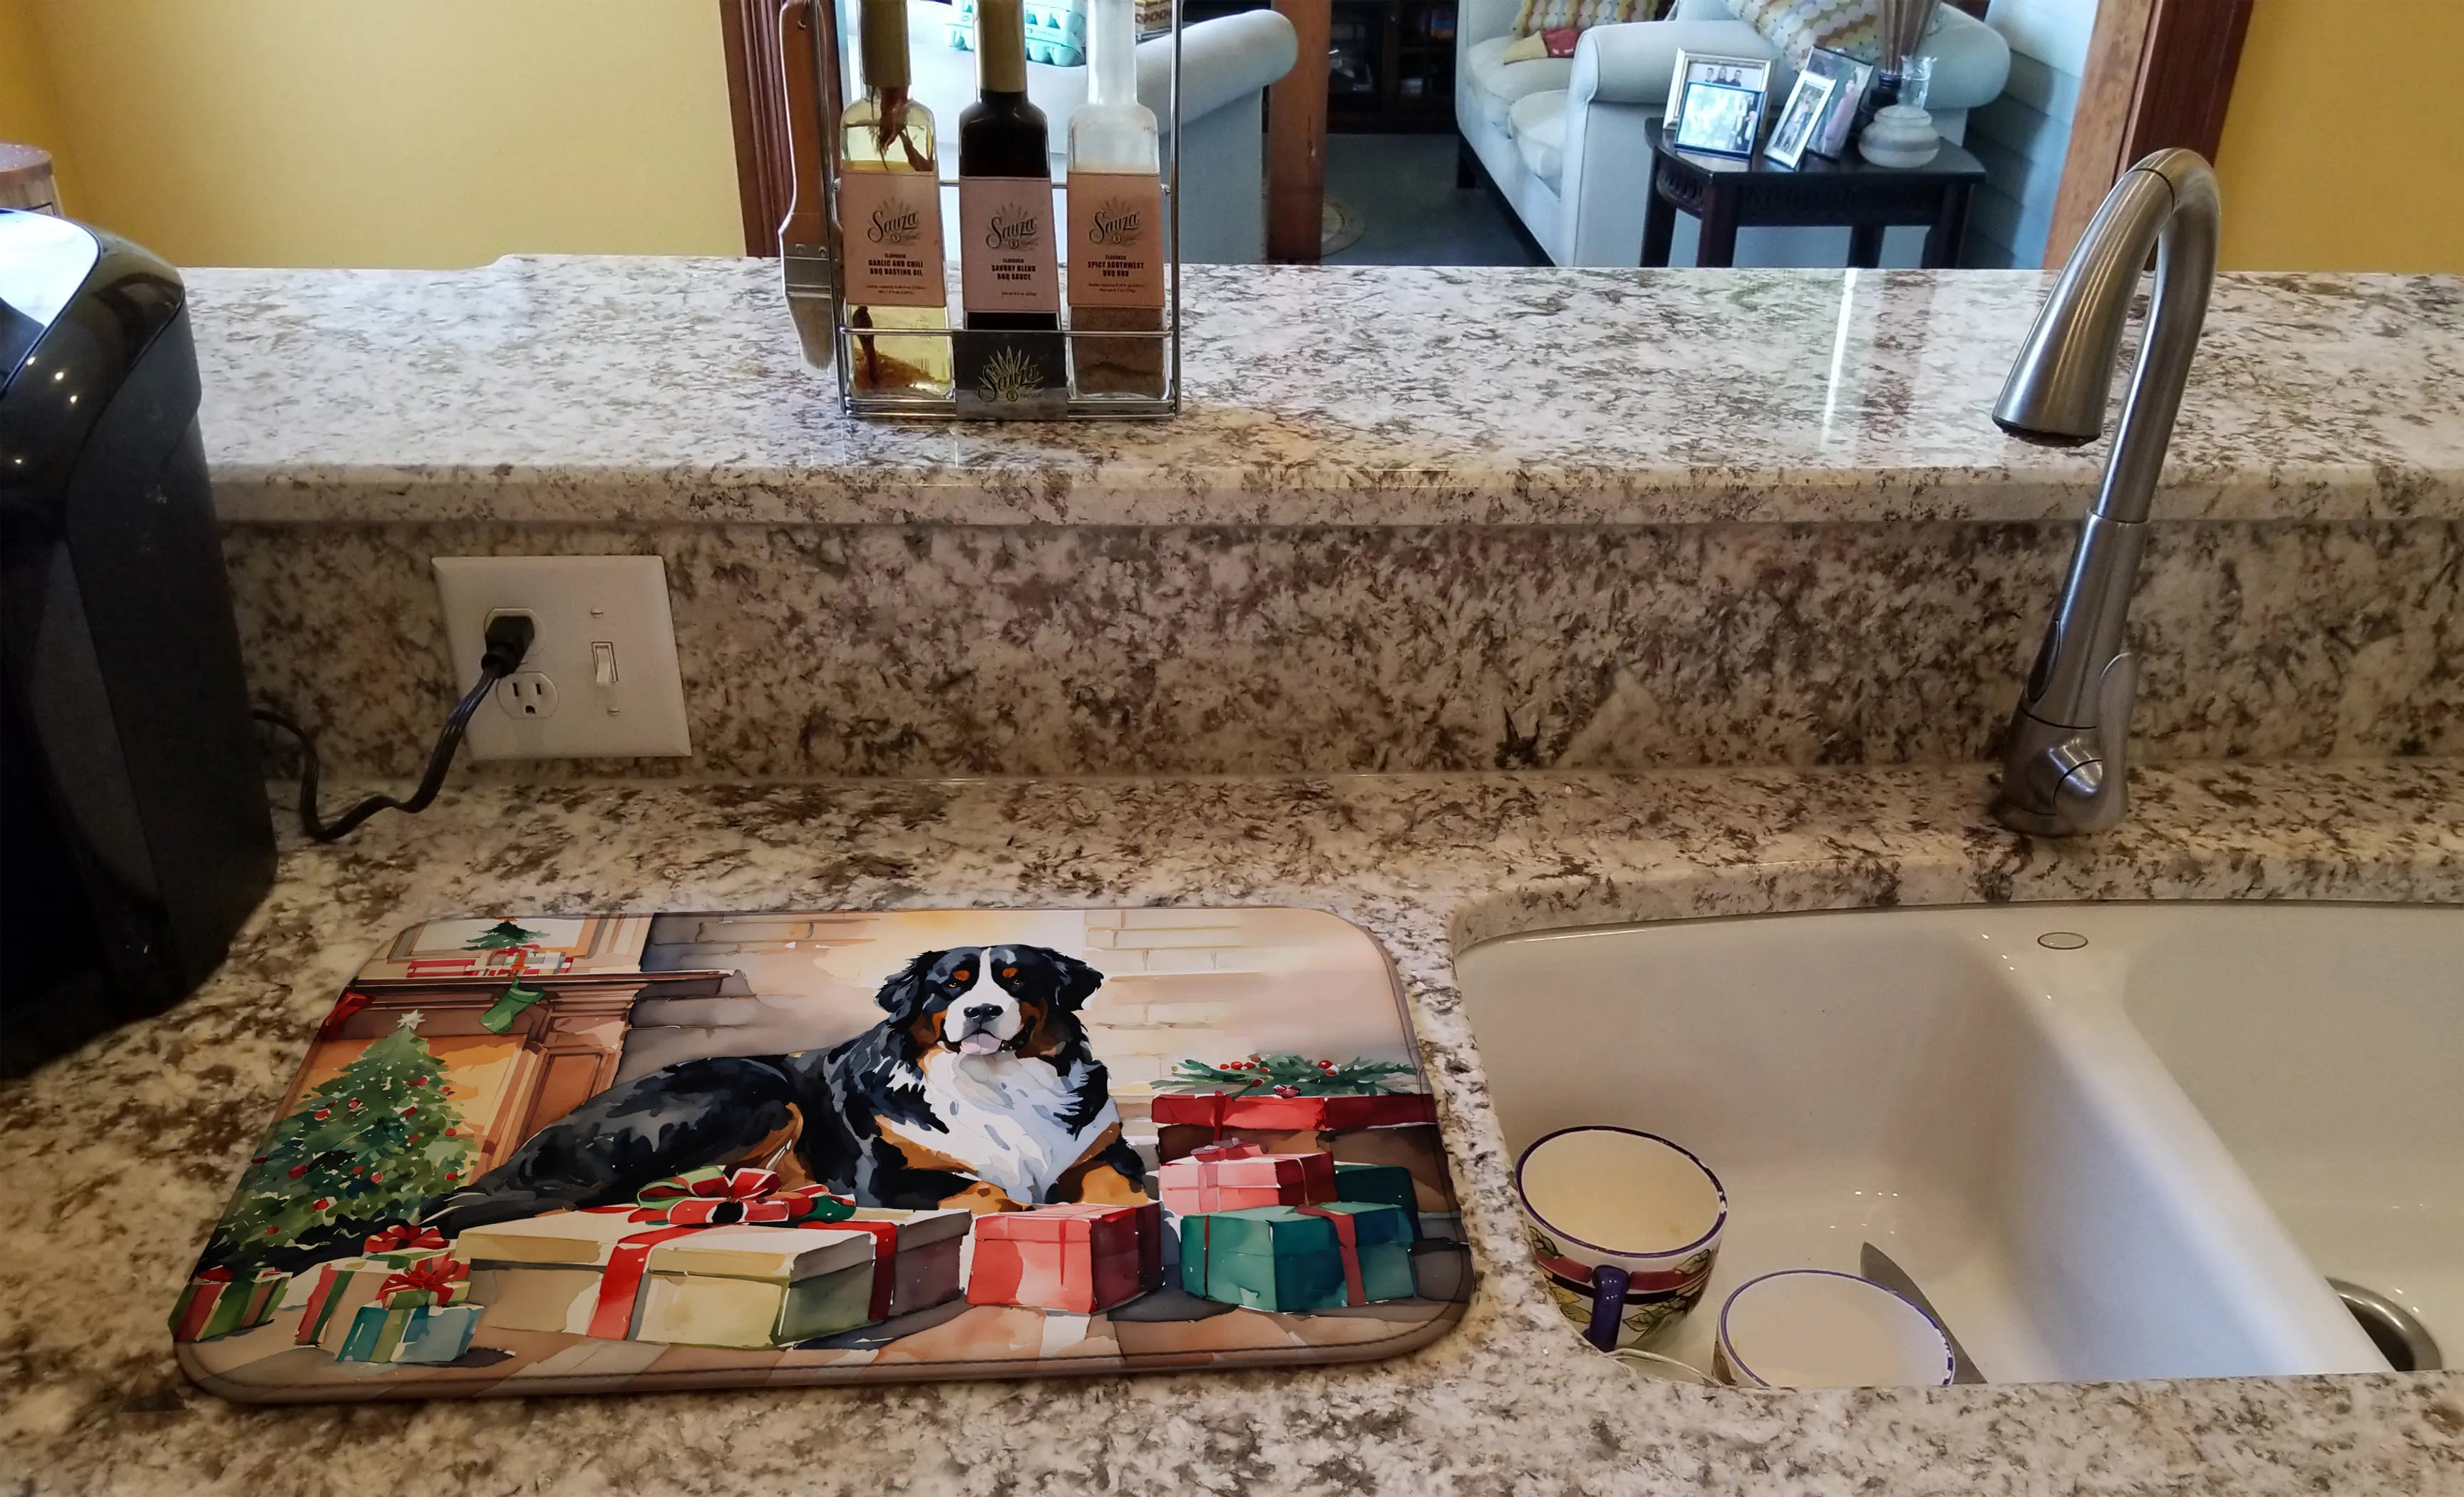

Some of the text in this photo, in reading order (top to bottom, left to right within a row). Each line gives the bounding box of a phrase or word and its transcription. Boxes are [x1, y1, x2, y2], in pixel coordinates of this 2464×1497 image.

[867, 210, 918, 243] Sauza
[986, 216, 1037, 249] Sauza
[1089, 211, 1140, 244] Sauza
